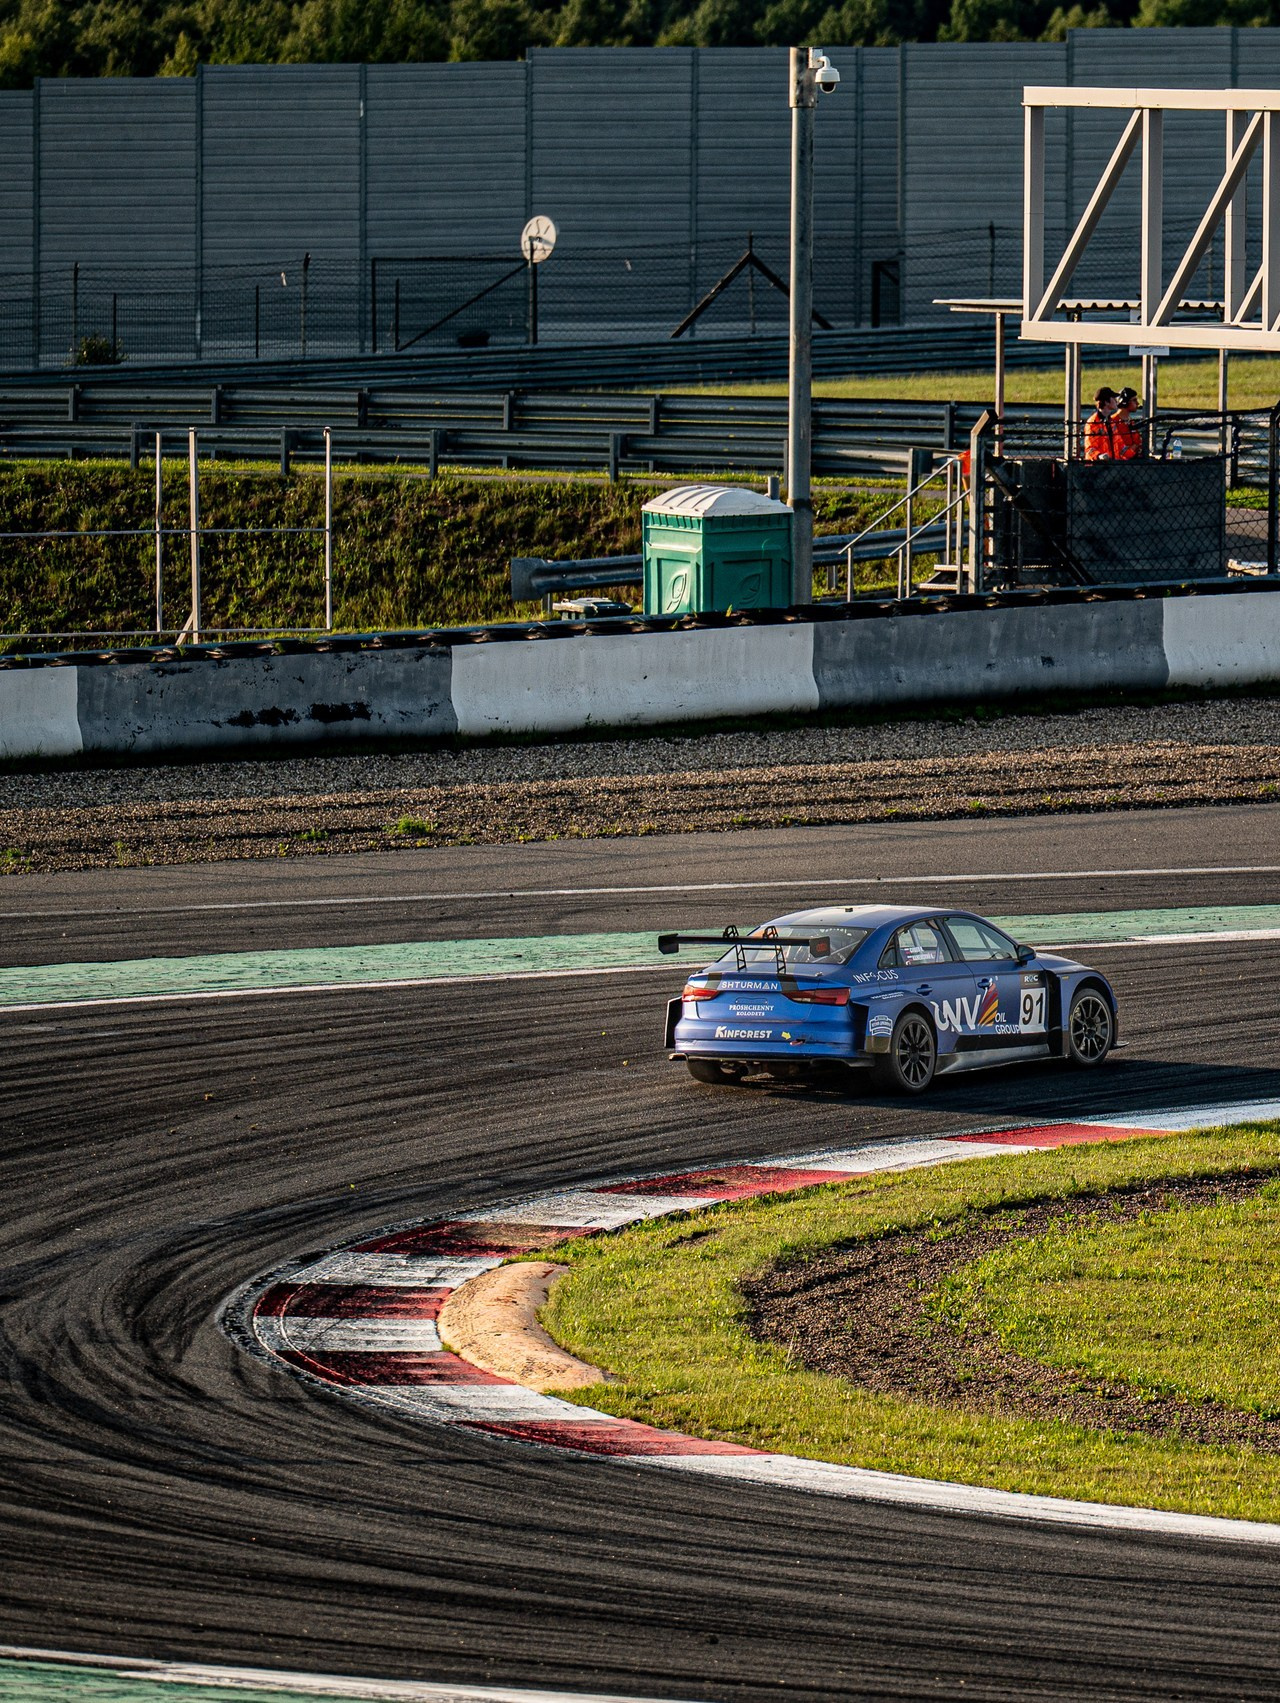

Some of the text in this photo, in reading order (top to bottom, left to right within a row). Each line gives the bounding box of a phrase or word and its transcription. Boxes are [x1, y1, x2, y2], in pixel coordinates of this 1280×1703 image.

[721, 981, 778, 990] SHTURMAN
[1022, 993, 1043, 1025] 91
[995, 1012, 1007, 1023] OIL
[995, 1024, 1021, 1035] GROUP
